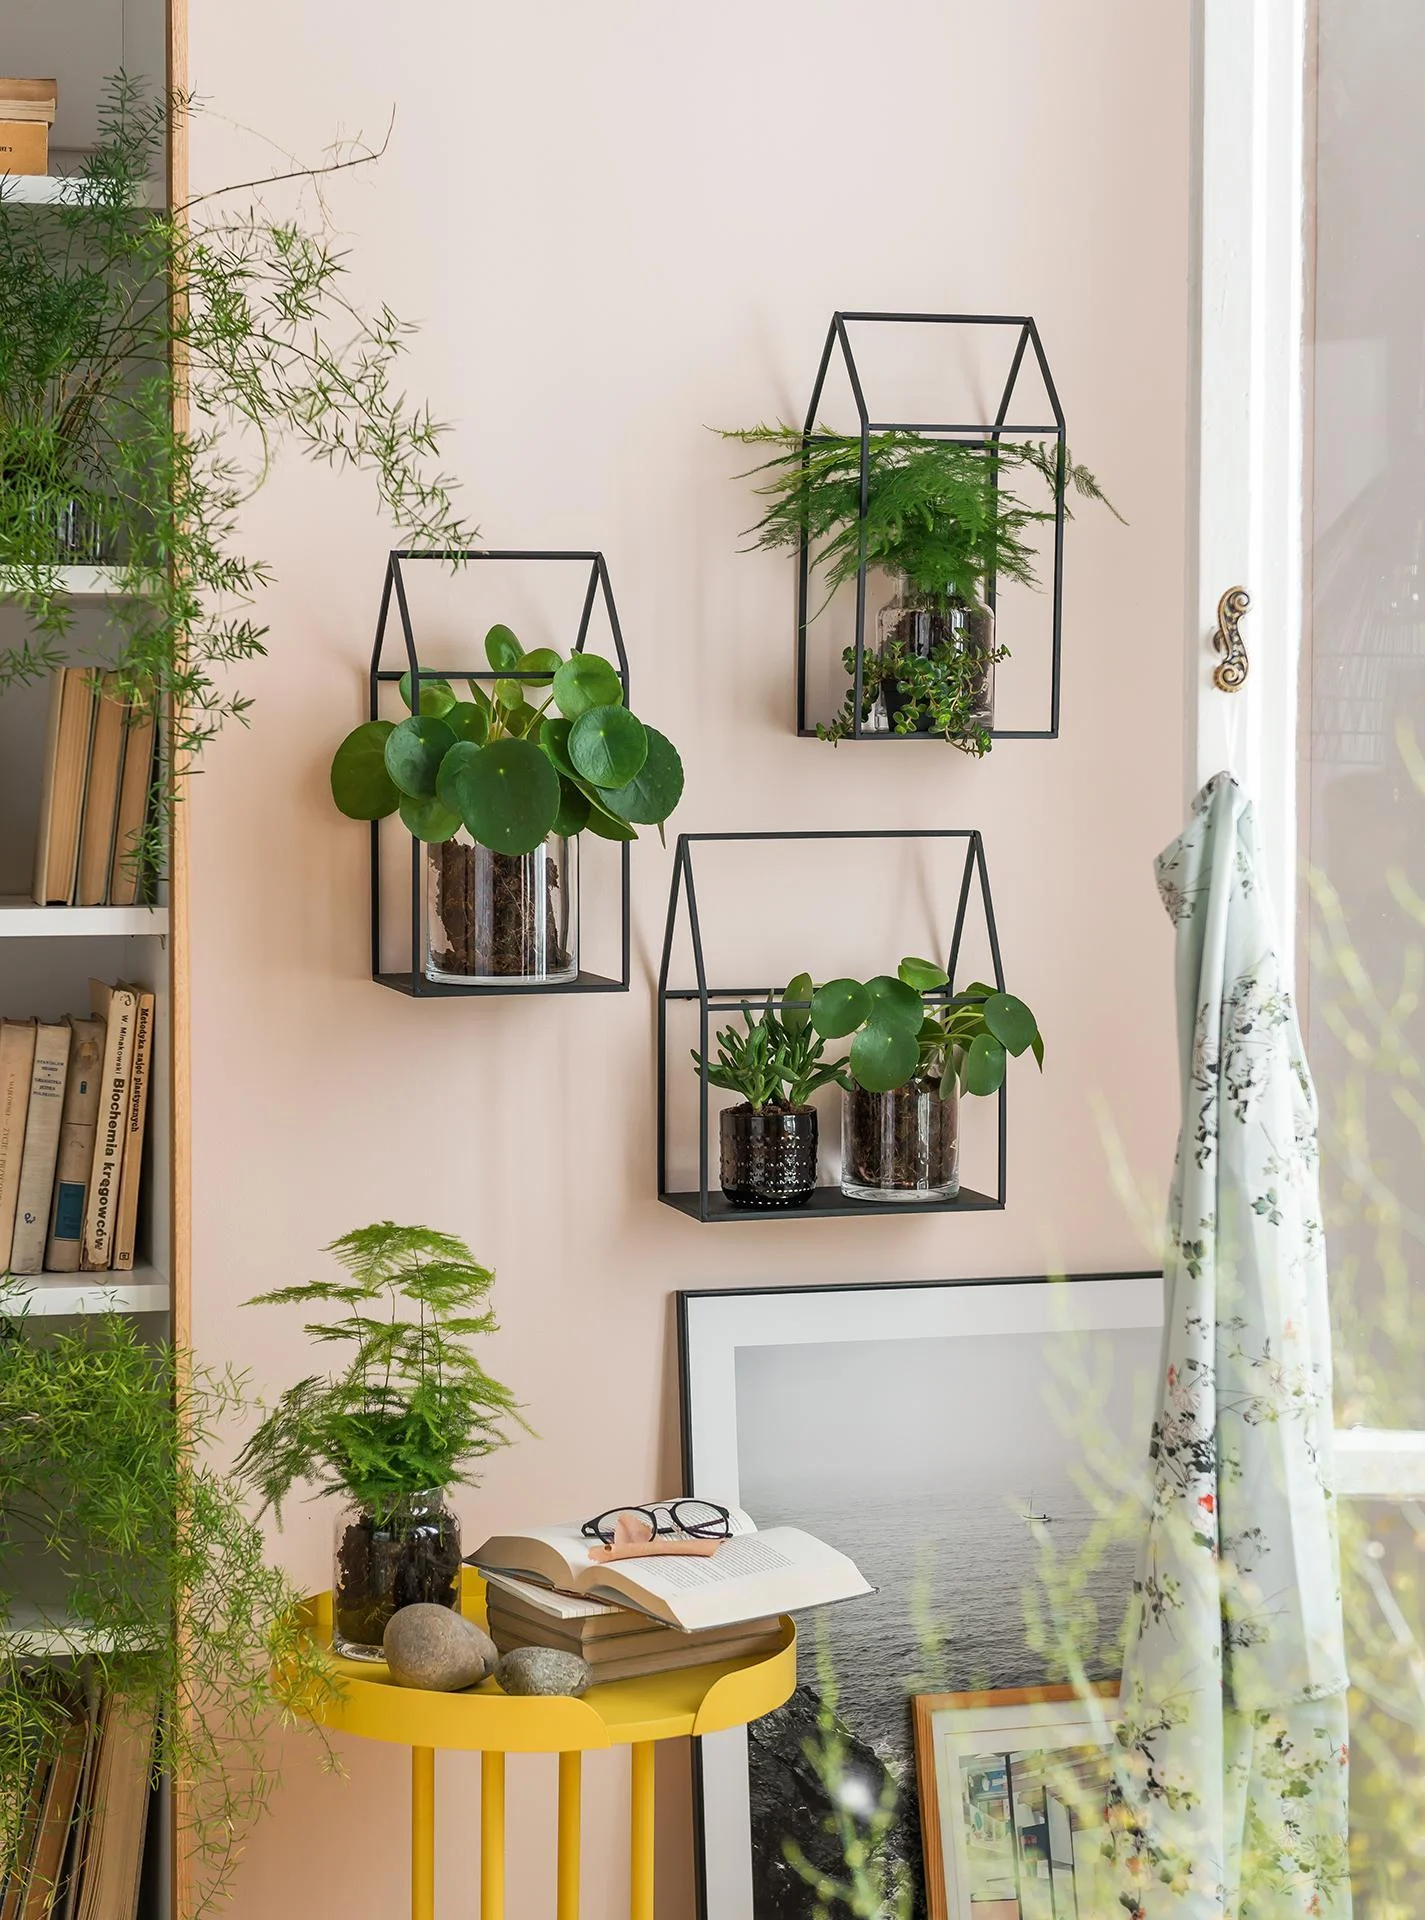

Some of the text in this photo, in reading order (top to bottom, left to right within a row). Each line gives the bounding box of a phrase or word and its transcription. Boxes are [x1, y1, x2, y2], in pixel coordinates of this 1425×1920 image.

[114, 1027, 127, 1075] Minakowski
[137, 1008, 149, 1049] Metodyka
[105, 1078, 125, 1157] Biochemia
[131, 1077, 143, 1132] plastycznych
[94, 1162, 115, 1251] kręgowców
